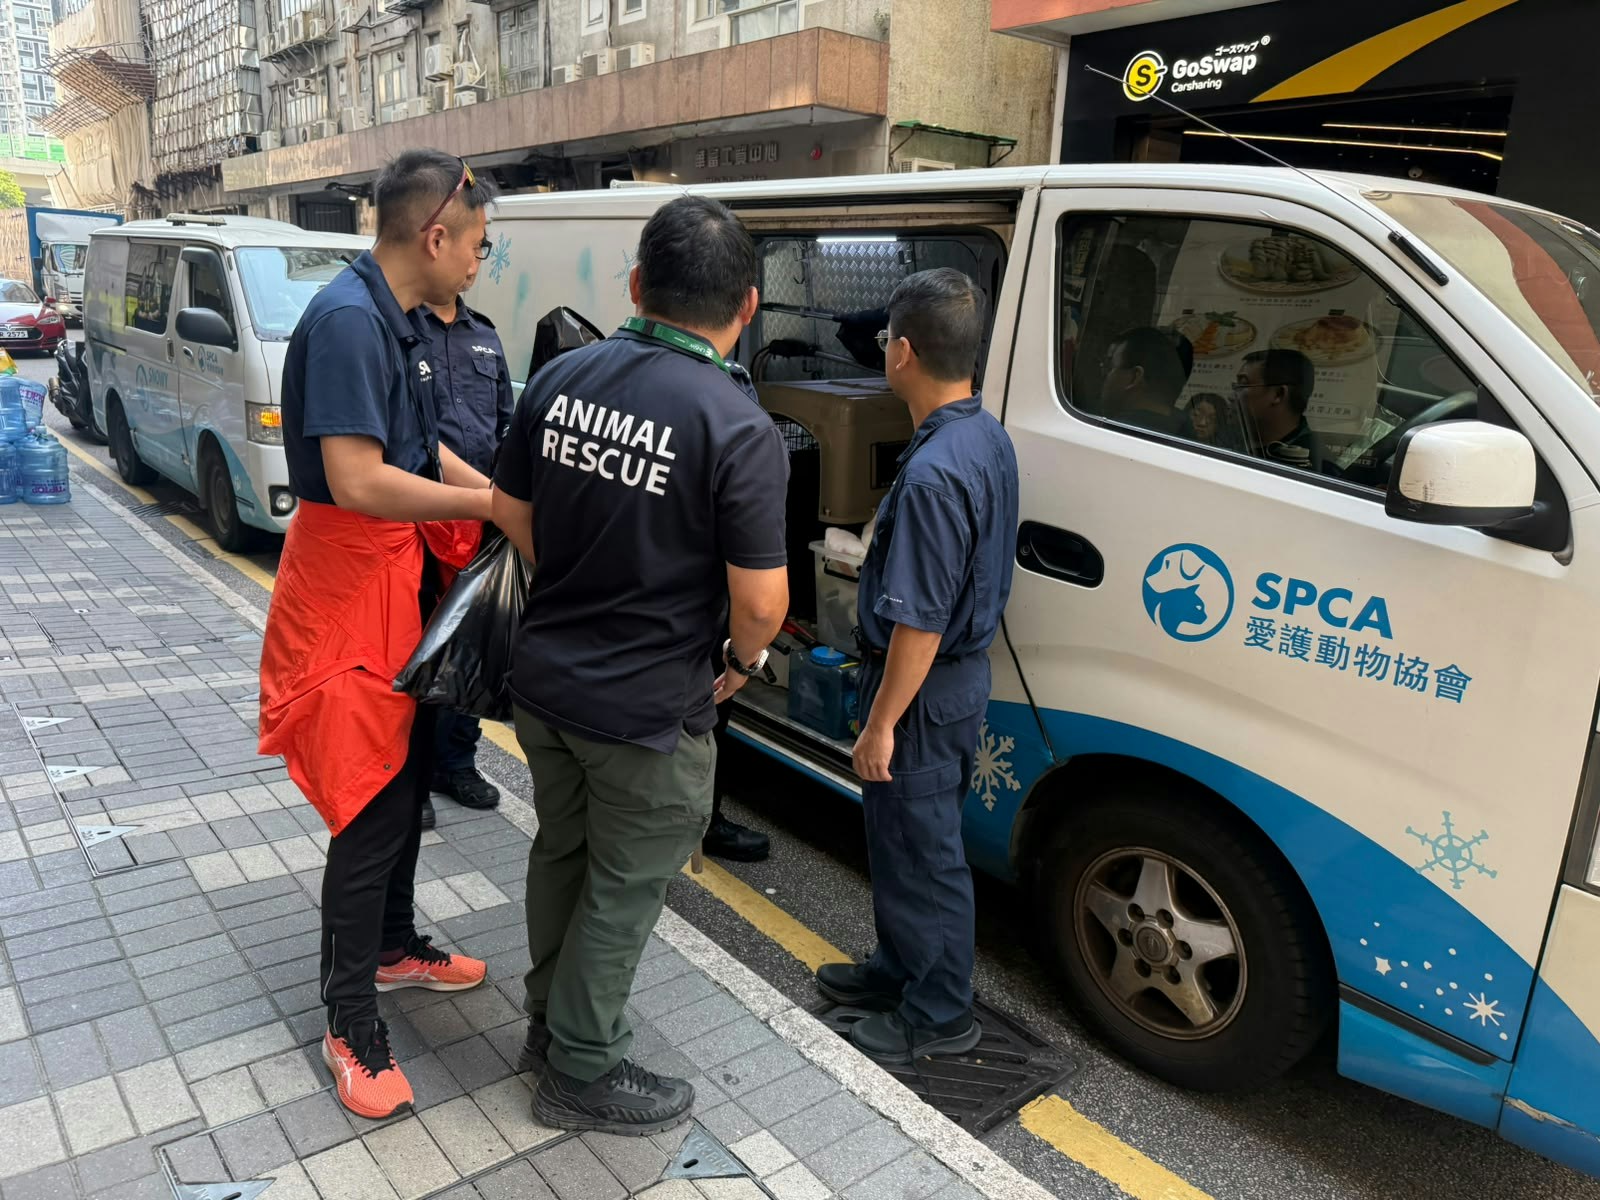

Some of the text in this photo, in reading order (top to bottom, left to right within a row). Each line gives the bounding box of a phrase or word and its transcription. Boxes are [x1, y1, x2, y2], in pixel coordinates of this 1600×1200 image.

[1172, 54, 1257, 79] GoSwap
[1215, 41, 1259, 56] ゴースワップ
[1171, 79, 1222, 93] Carsharing
[545, 394, 676, 460] ANIMAL
[541, 428, 670, 496] RESCUE
[1251, 572, 1393, 640] SPCA
[1243, 615, 1473, 704] 愛護動物協會
